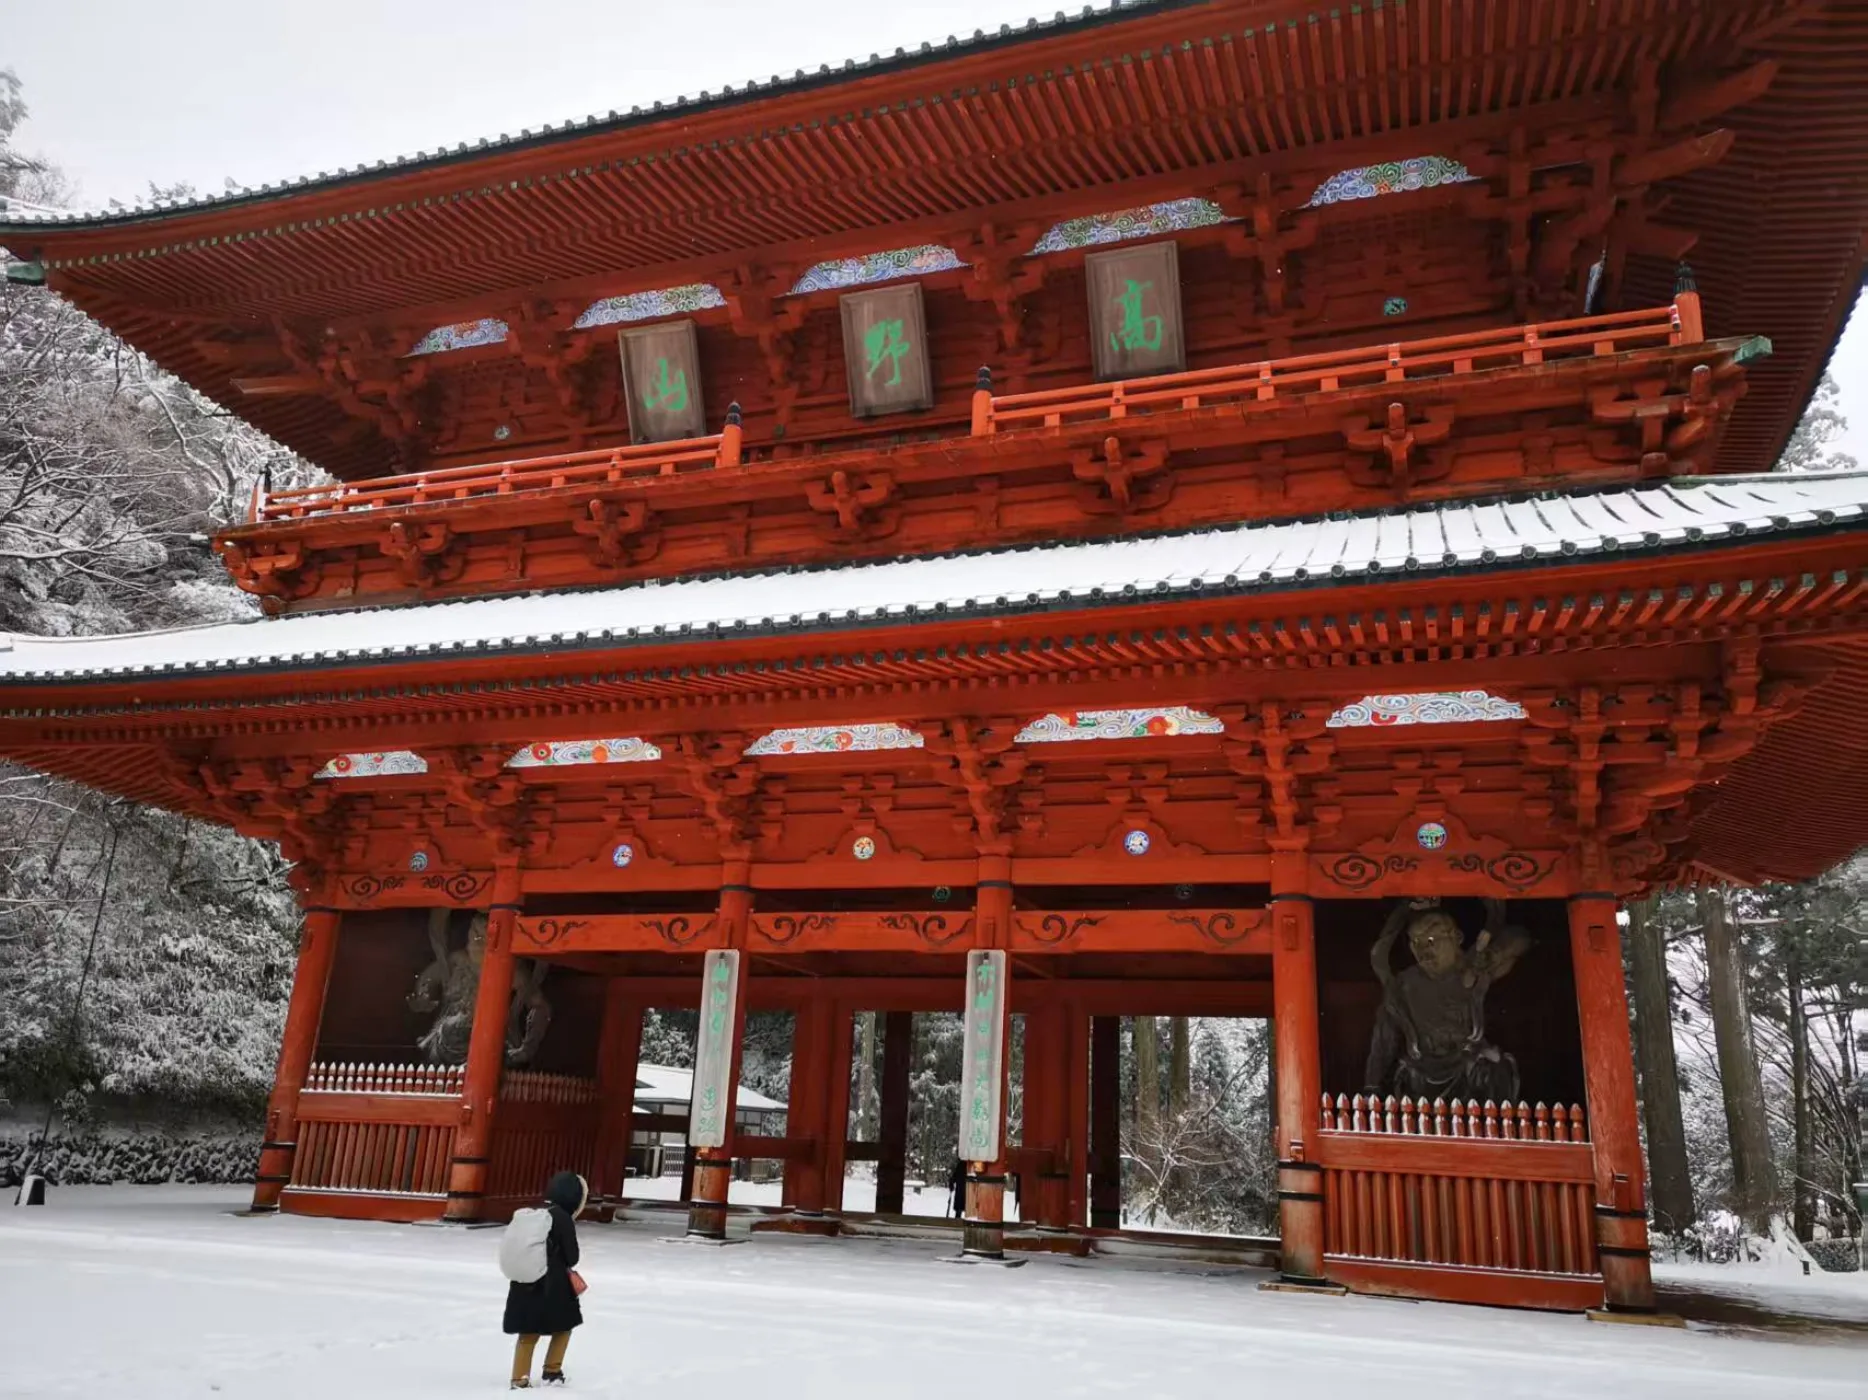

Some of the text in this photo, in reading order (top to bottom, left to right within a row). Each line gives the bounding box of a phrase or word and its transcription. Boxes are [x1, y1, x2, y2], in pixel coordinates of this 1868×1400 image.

[1111, 279, 1163, 352] 高
[644, 357, 687, 411] 山
[864, 318, 911, 386] 野
